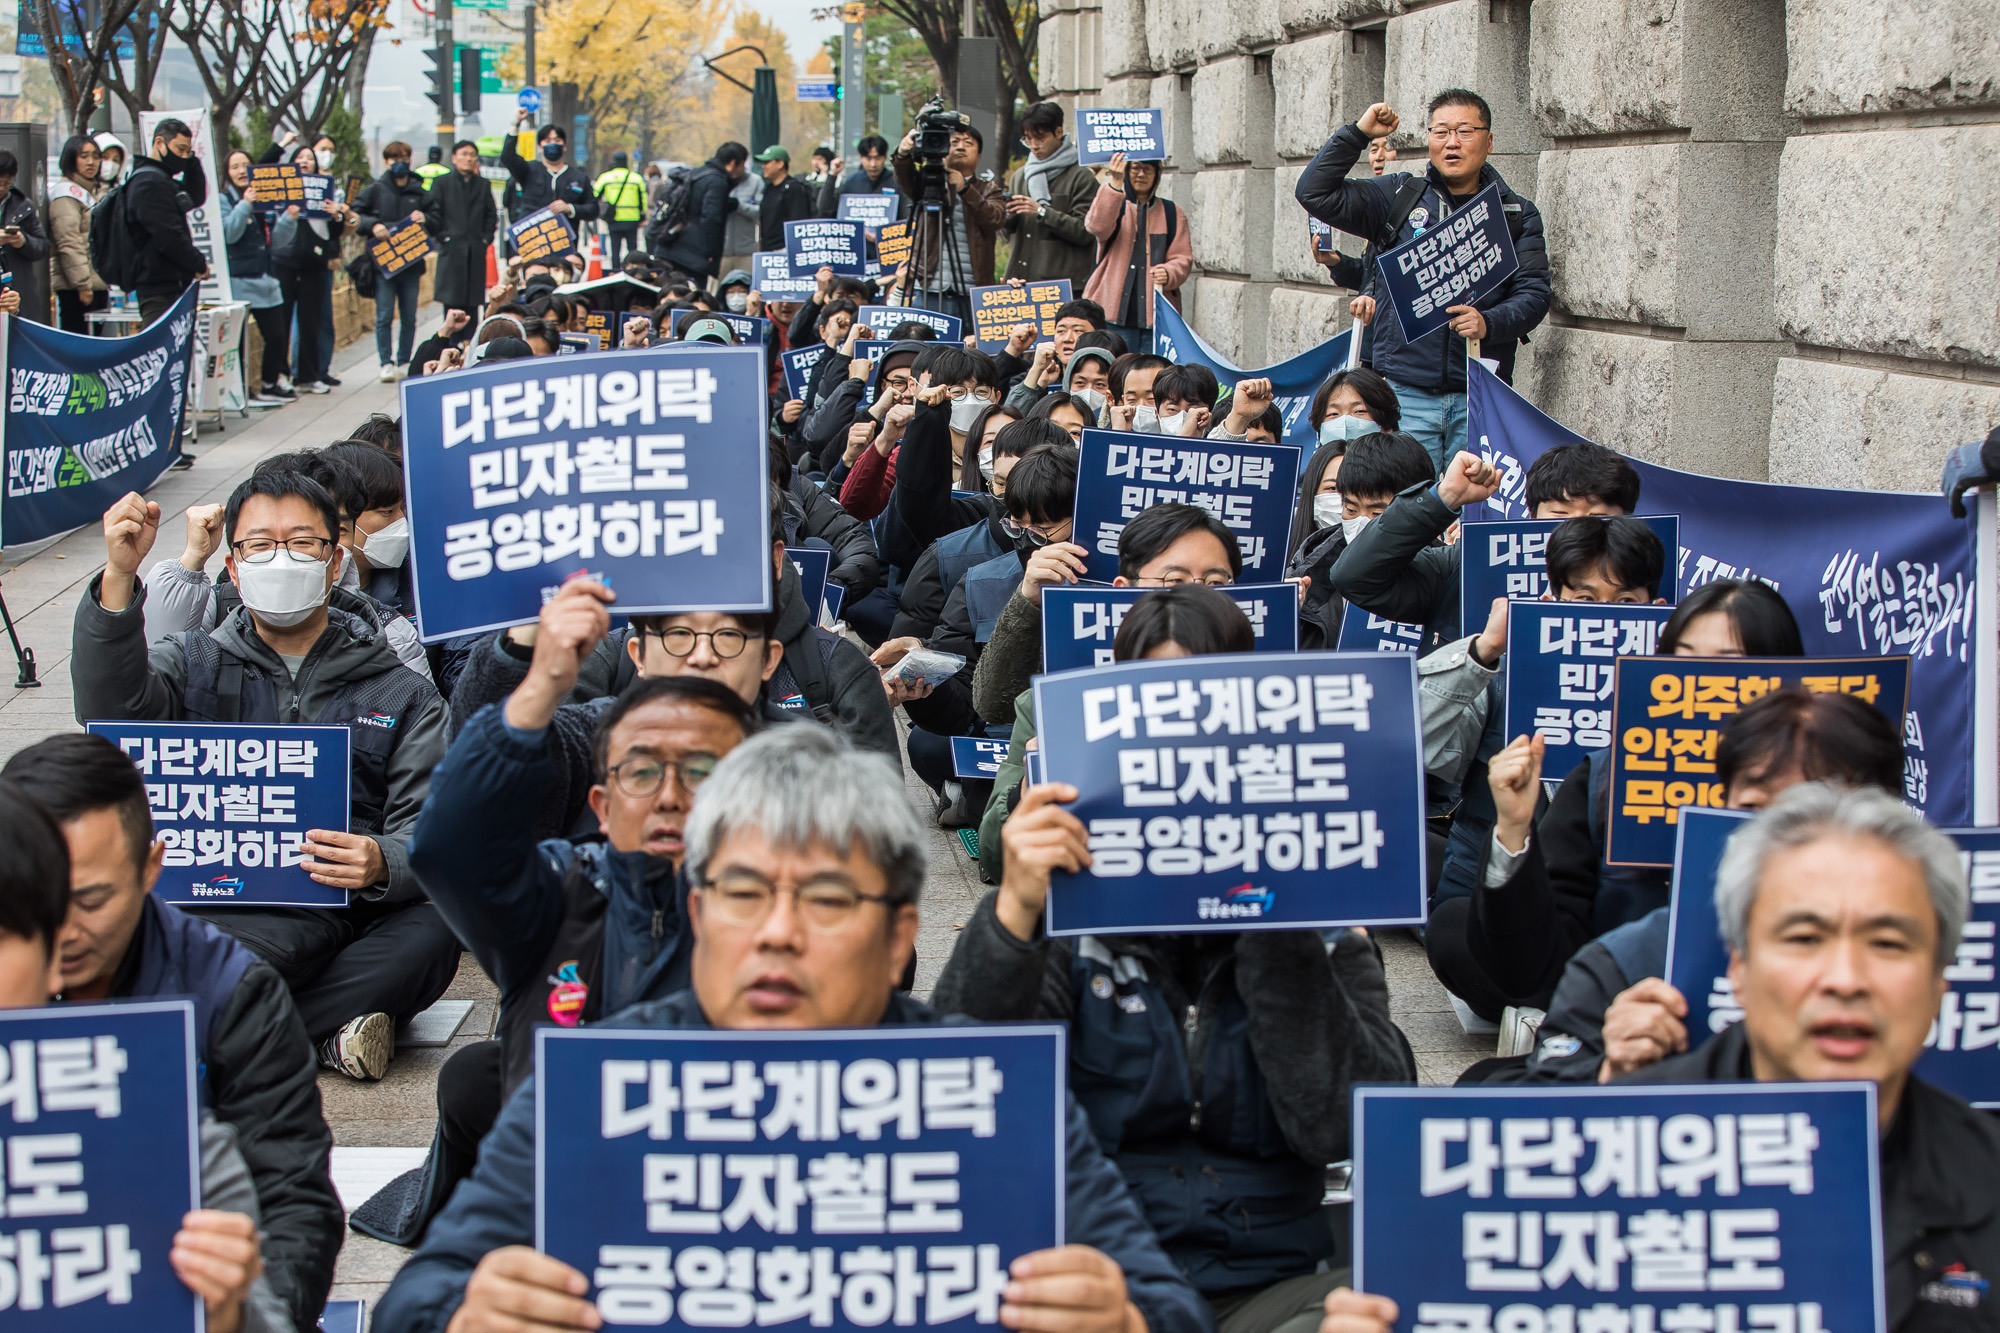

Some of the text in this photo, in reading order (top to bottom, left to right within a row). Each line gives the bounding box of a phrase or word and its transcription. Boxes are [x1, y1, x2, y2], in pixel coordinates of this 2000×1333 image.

[793, 223, 857, 239] 다단계위탁
[795, 251, 858, 267] 공영화하라
[801, 238, 851, 251] 민자철도
[1397, 200, 1490, 275] 다단계위탁
[1415, 228, 1490, 291] 민자철도
[982, 286, 1061, 307] 외주화 중단
[1411, 243, 1503, 319] 공영화하라
[976, 304, 1036, 325] 안전인력
[440, 367, 718, 450] 다단계위탁
[468, 433, 689, 510] 민자철도
[1106, 444, 1274, 490] 다단계위탁
[443, 499, 726, 582] 공영화하라
[1540, 617, 1668, 656] 다단계
[1082, 673, 1373, 743] 다단계위탁
[120, 737, 318, 778] 다단계위탁
[1118, 742, 1349, 807] 민자철도
[146, 783, 297, 823] 민자철도
[150, 829, 315, 868] 영화하라
[1088, 810, 1384, 878] 공영화하라
[192, 888, 235, 896] 공공운수노조
[600, 1056, 1003, 1142] 다단계위탁
[1420, 1112, 1820, 1199] 다단계위탁
[643, 1151, 963, 1234] 민자철도
[1462, 1208, 1785, 1293] 민자철도
[594, 1244, 1008, 1328] 공영화하라
